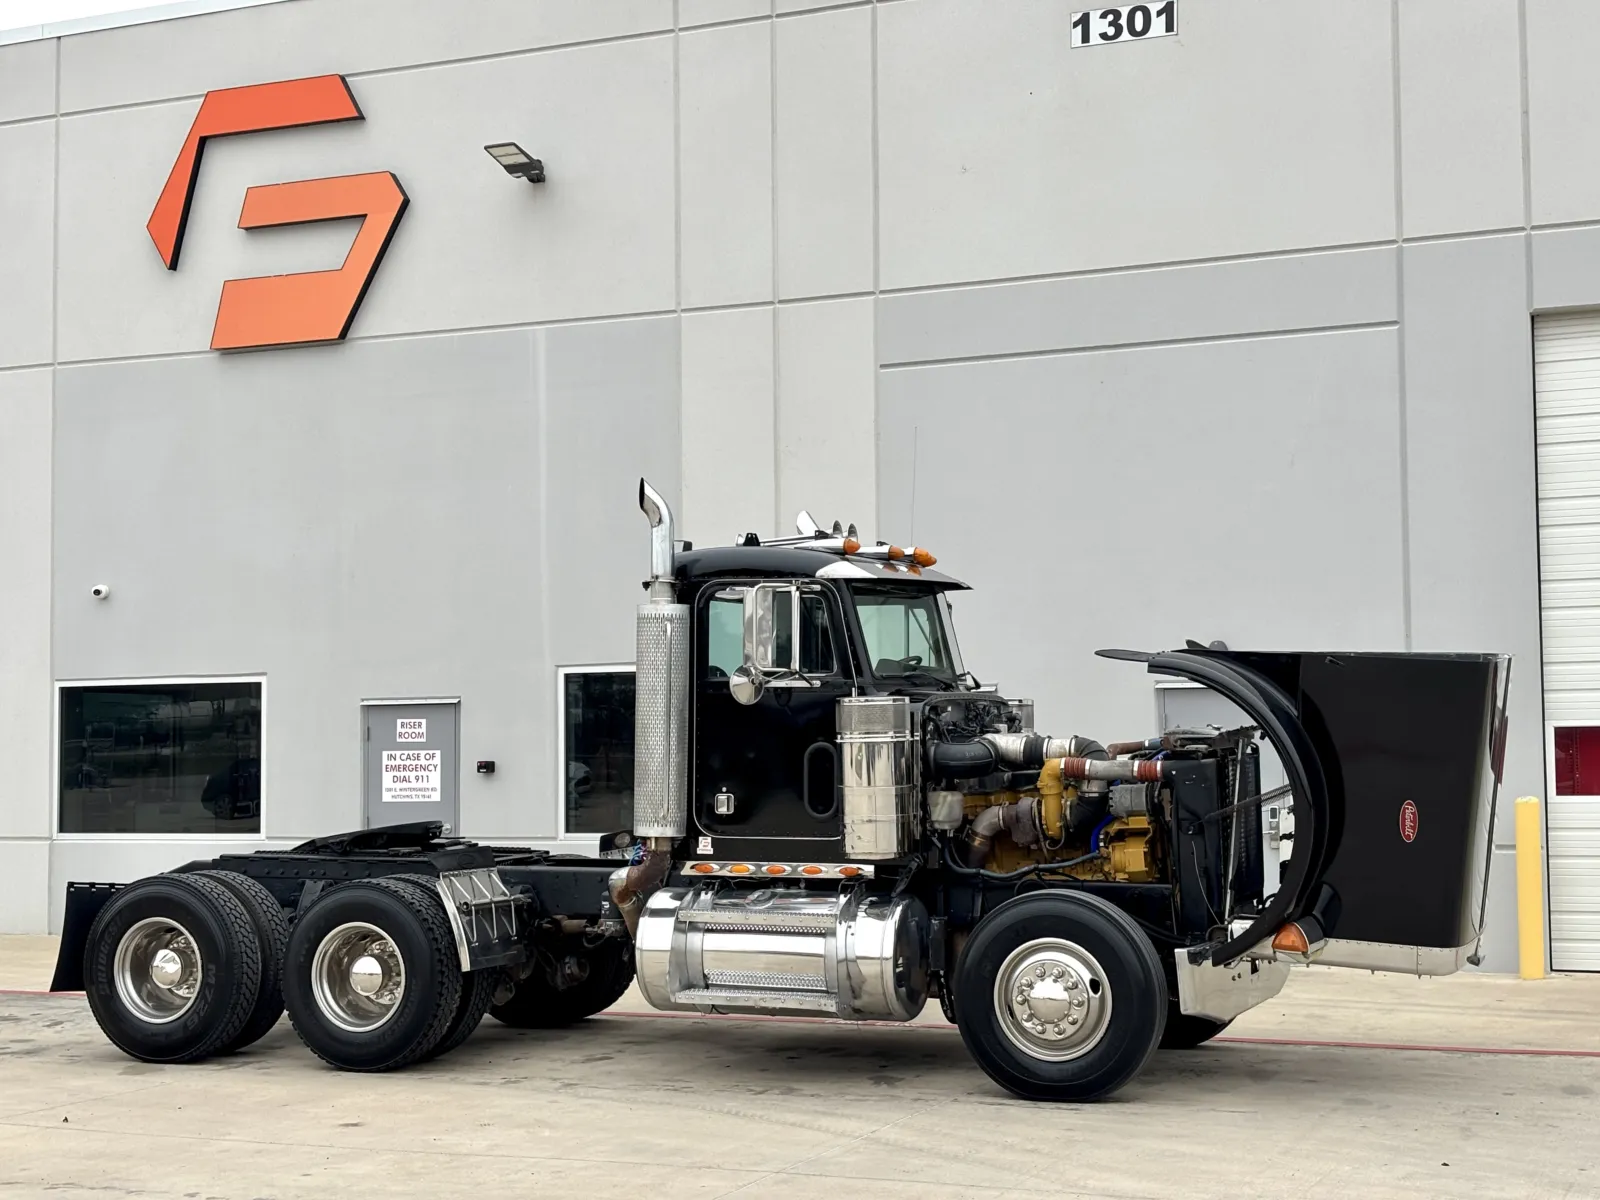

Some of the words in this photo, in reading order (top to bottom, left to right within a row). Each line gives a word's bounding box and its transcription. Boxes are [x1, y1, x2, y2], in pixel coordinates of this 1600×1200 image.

[1072, 1, 1175, 44] 1301
[400, 721, 423, 729] RISER
[398, 731, 424, 739] ROOM
[387, 753, 397, 762] IN
[399, 752, 421, 762] CASE
[424, 752, 436, 761] OF
[385, 763, 438, 773] EMERGENCY
[392, 775, 412, 783] DIAL
[414, 775, 430, 783] 911
